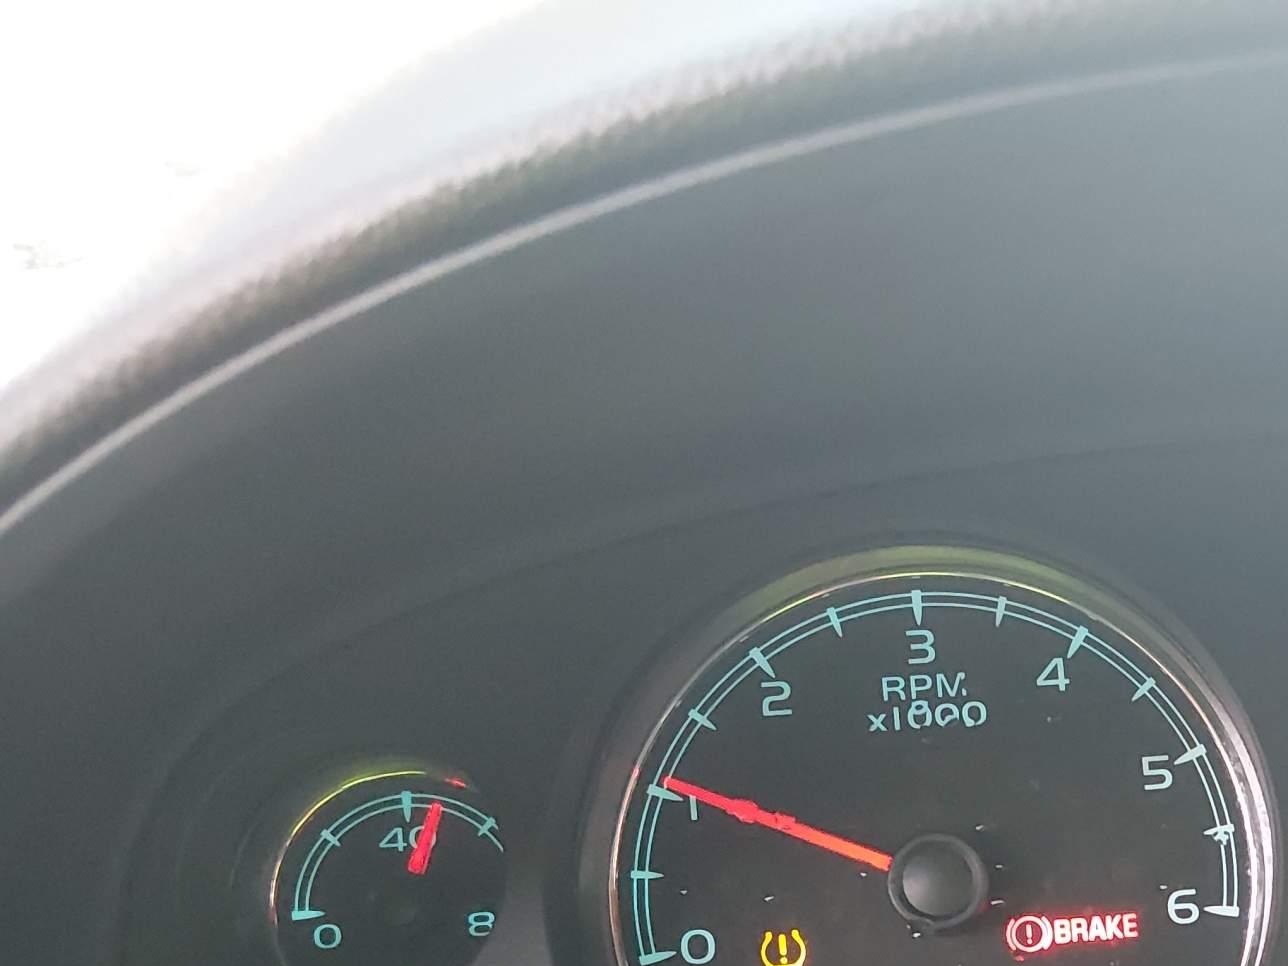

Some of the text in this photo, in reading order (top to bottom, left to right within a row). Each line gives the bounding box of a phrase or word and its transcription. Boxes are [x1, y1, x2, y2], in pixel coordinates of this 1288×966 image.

[905, 629, 936, 664] 3
[881, 672, 967, 702] RPM
[1035, 657, 1070, 693] 4
[761, 681, 793, 718] 2
[1141, 754, 1173, 791] 5
[1167, 889, 1200, 925] 6
[313, 923, 343, 949] 0
[680, 929, 716, 964] 0
[1053, 912, 1139, 946] BRAKE
